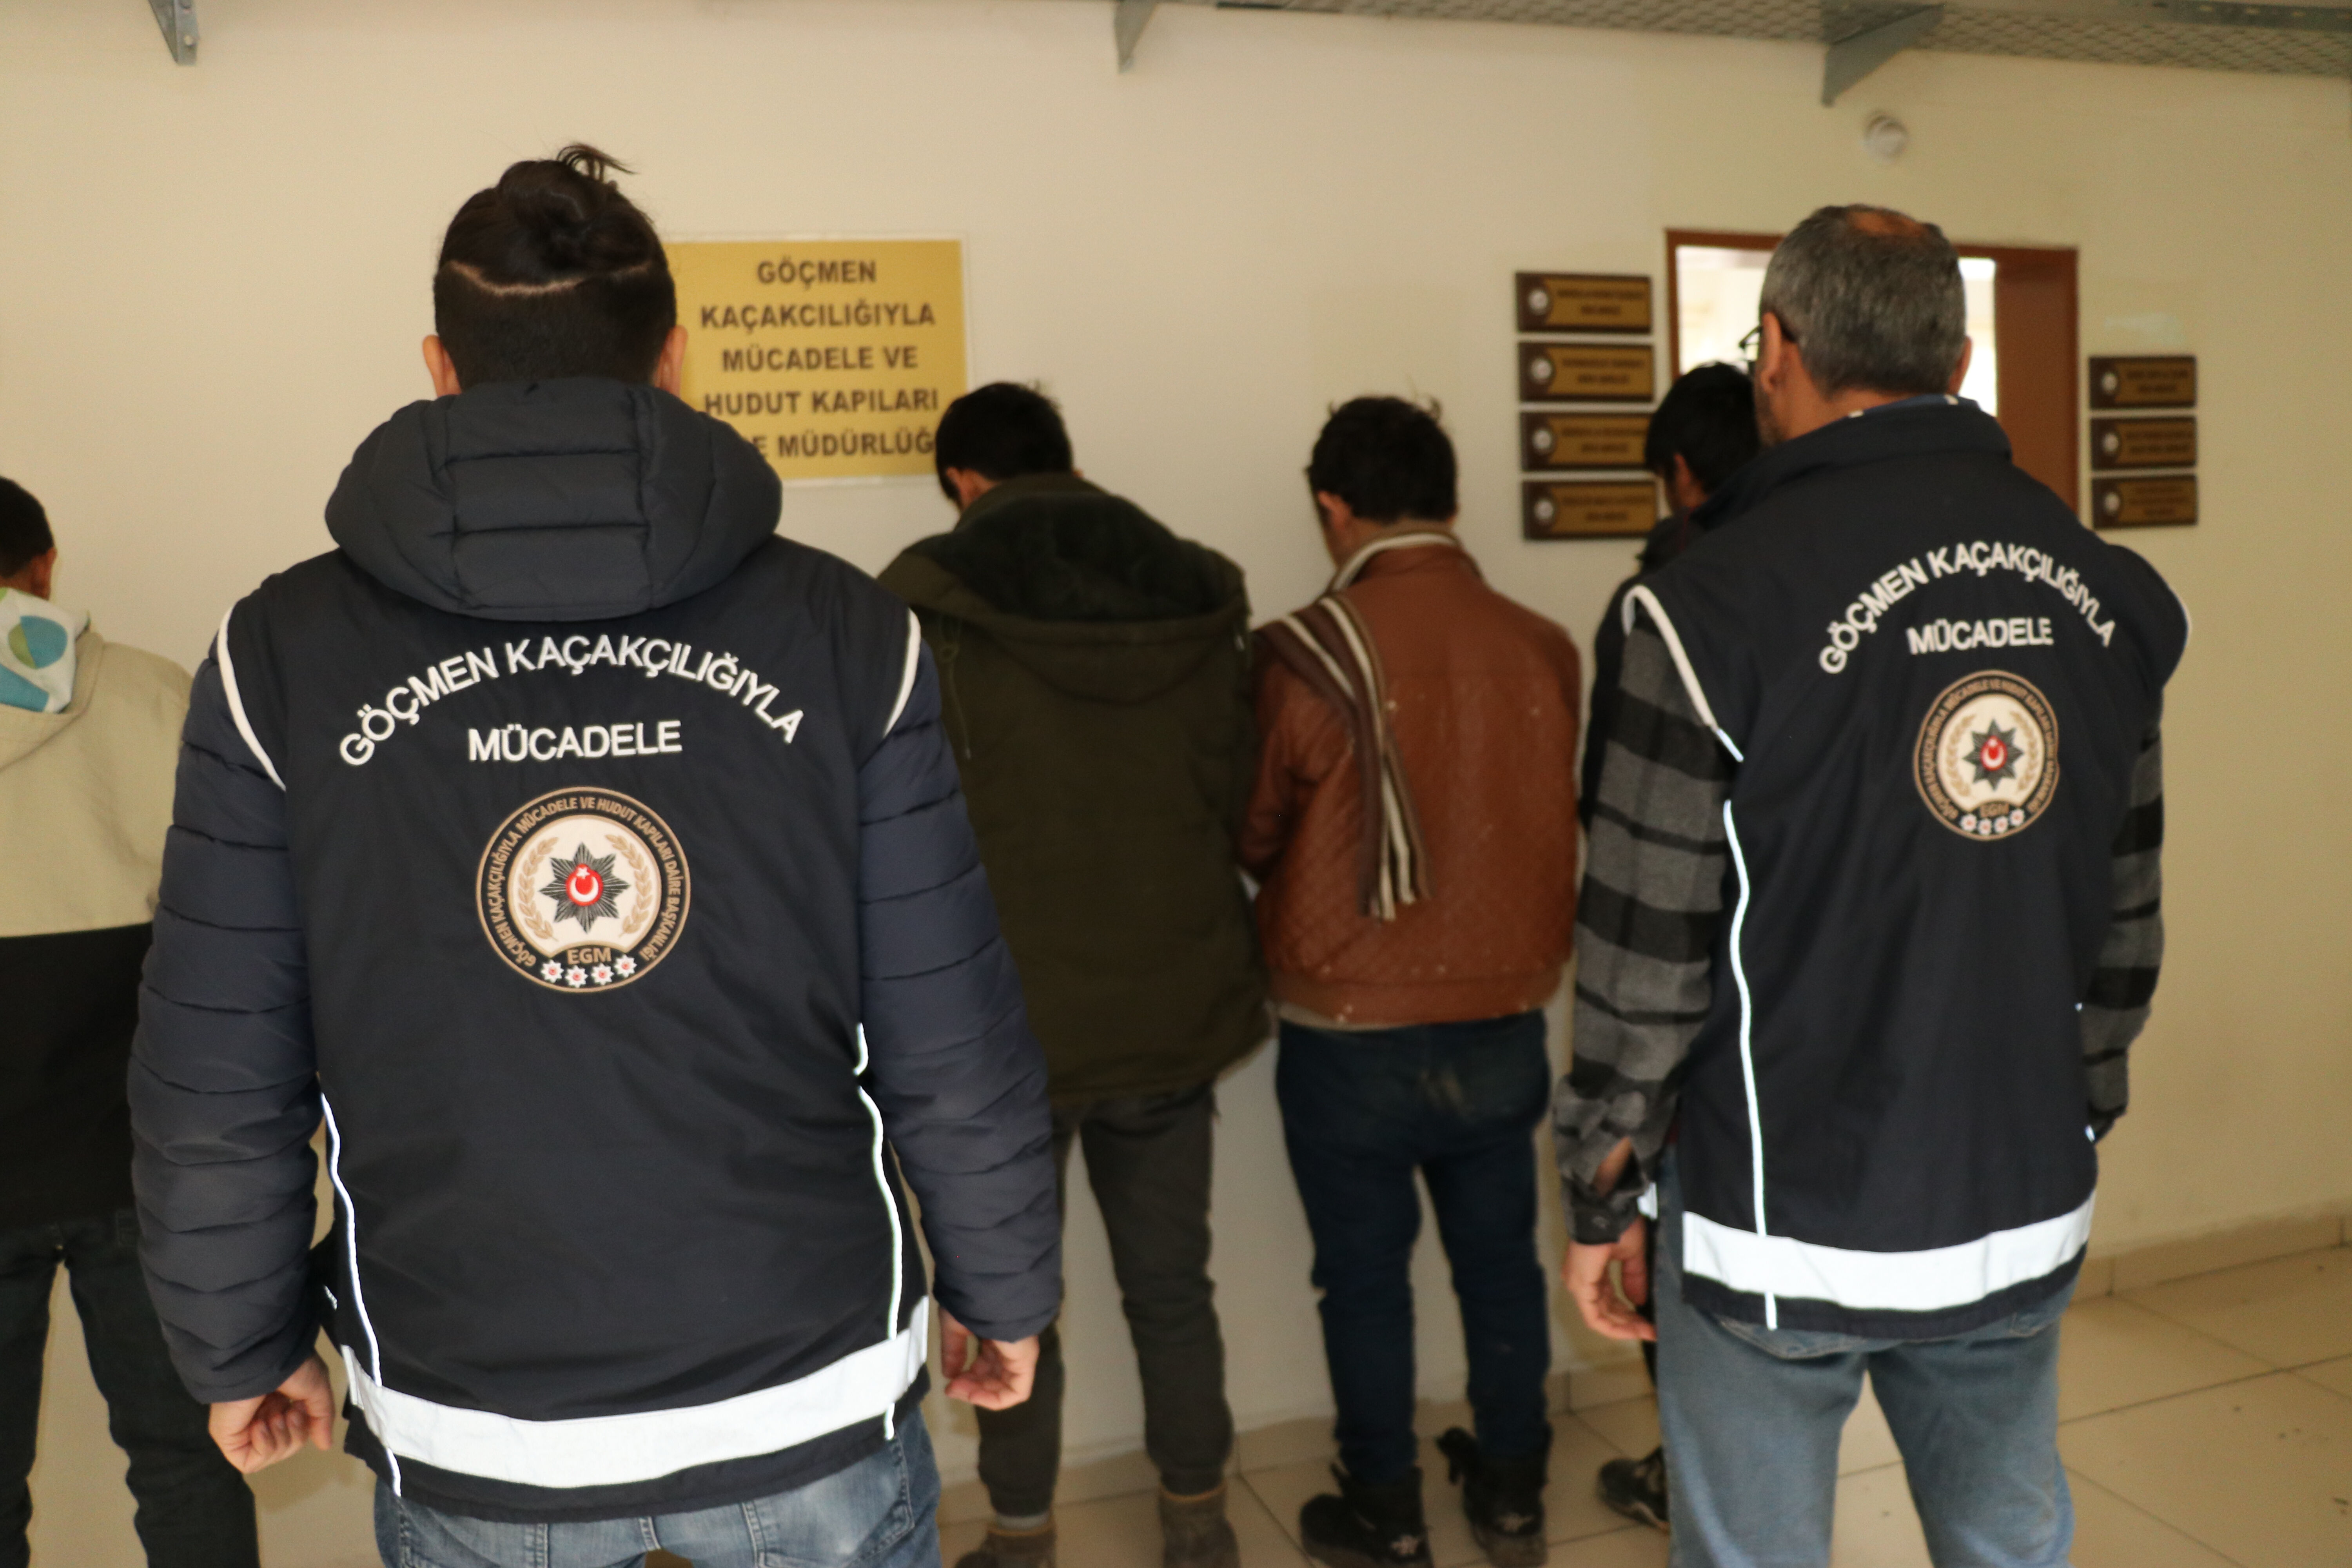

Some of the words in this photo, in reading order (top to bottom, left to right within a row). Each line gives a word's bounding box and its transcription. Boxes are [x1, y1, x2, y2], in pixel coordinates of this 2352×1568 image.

[757, 256, 877, 289] GÖÇMEN
[701, 298, 936, 334] KAÇAKCILIĞIYLA
[722, 345, 874, 372] MÜCADELE
[883, 346, 918, 369] VE
[706, 391, 801, 416] HUDUT
[812, 388, 939, 413] KAPILARI
[778, 425, 937, 457] MÜDÜRLÜĞ
[1819, 559, 1929, 673] GÖÇMEN
[1927, 541, 2115, 647] KAÇAKÇILIĞIYLA
[1907, 617, 2053, 655] MÜCADELE
[339, 647, 499, 766] GÖÇMEN
[505, 634, 804, 744] KAÇAKÇILIĞIYLA
[468, 720, 682, 762] MÜCADELE
[515, 797, 578, 834] MÜCADELE
[579, 797, 596, 809] VE
[596, 798, 637, 821] HUDUT
[664, 860, 684, 895] DAİRE
[495, 921, 536, 966] GÖÇMEN
[566, 947, 612, 965] EGM
